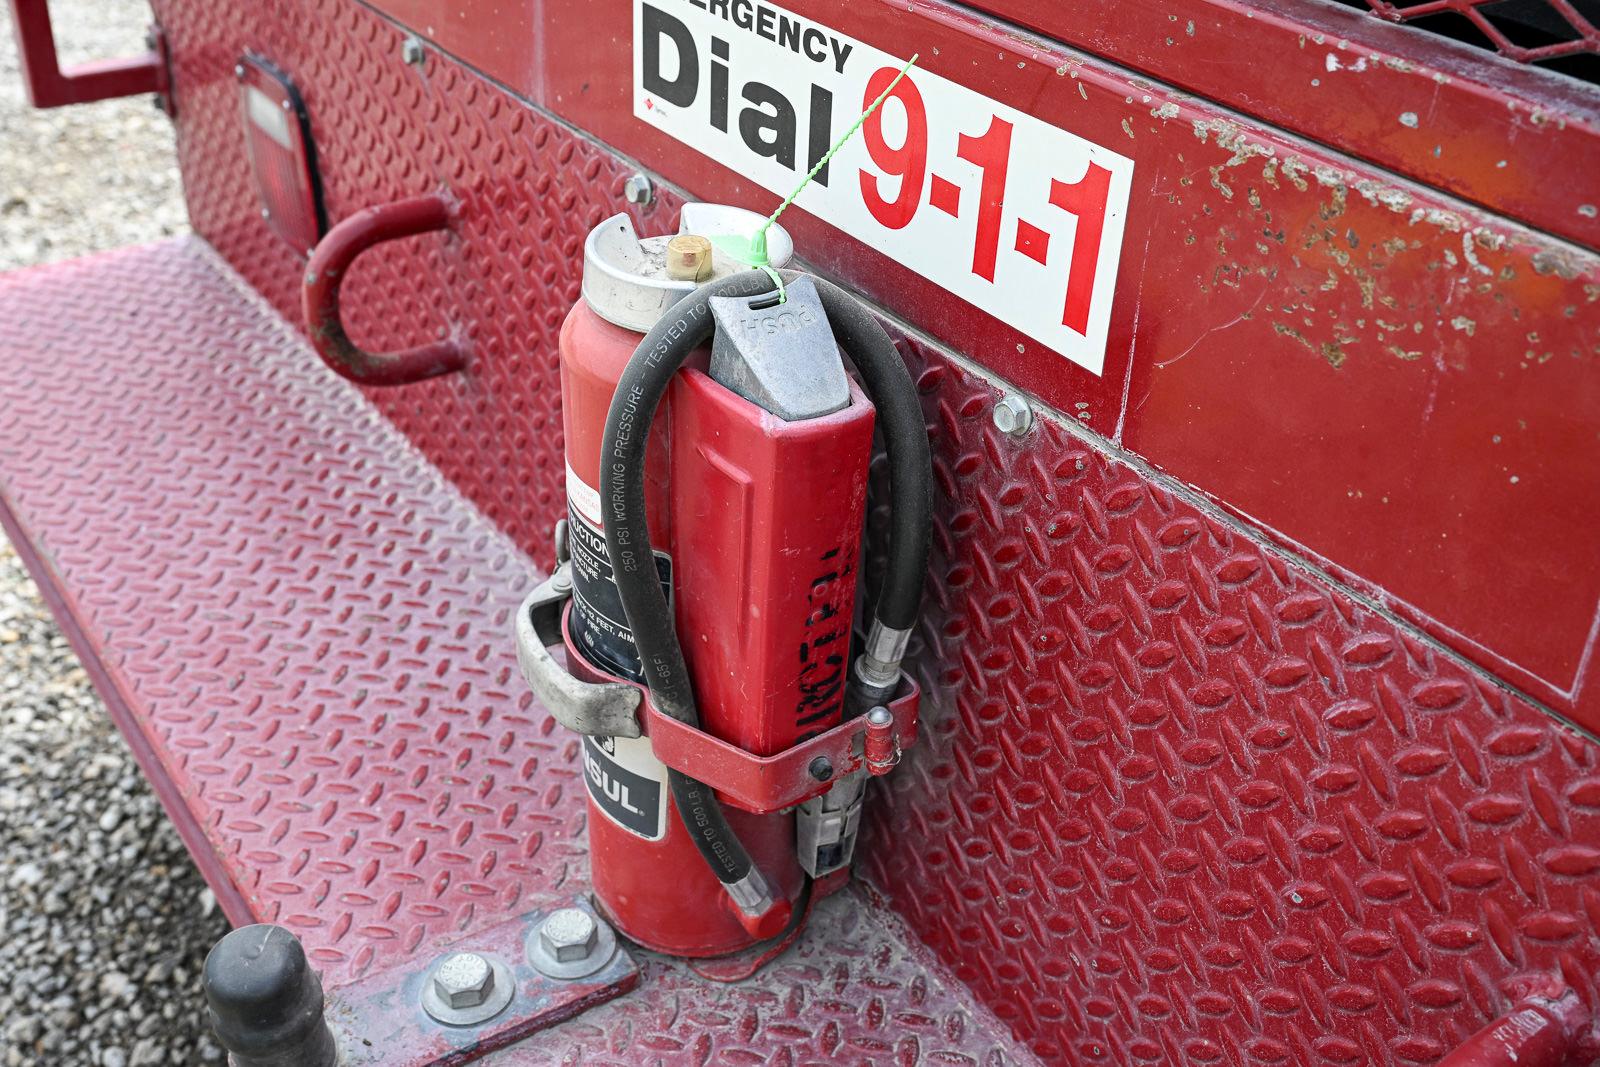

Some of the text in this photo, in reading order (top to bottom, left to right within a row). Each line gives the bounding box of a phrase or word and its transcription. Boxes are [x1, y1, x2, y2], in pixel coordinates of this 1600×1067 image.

[643, 3, 1112, 337] Dial 9-1-1
[687, 303, 706, 320] TO
[740, 305, 815, 335] PUSH
[644, 319, 687, 369] TESTED
[614, 384, 644, 458] PRESSURE
[613, 463, 627, 521] WORKING
[617, 527, 631, 545] PSI
[621, 550, 638, 573] 250
[618, 631, 635, 644] AIM
[712, 841, 736, 873] TESTED
